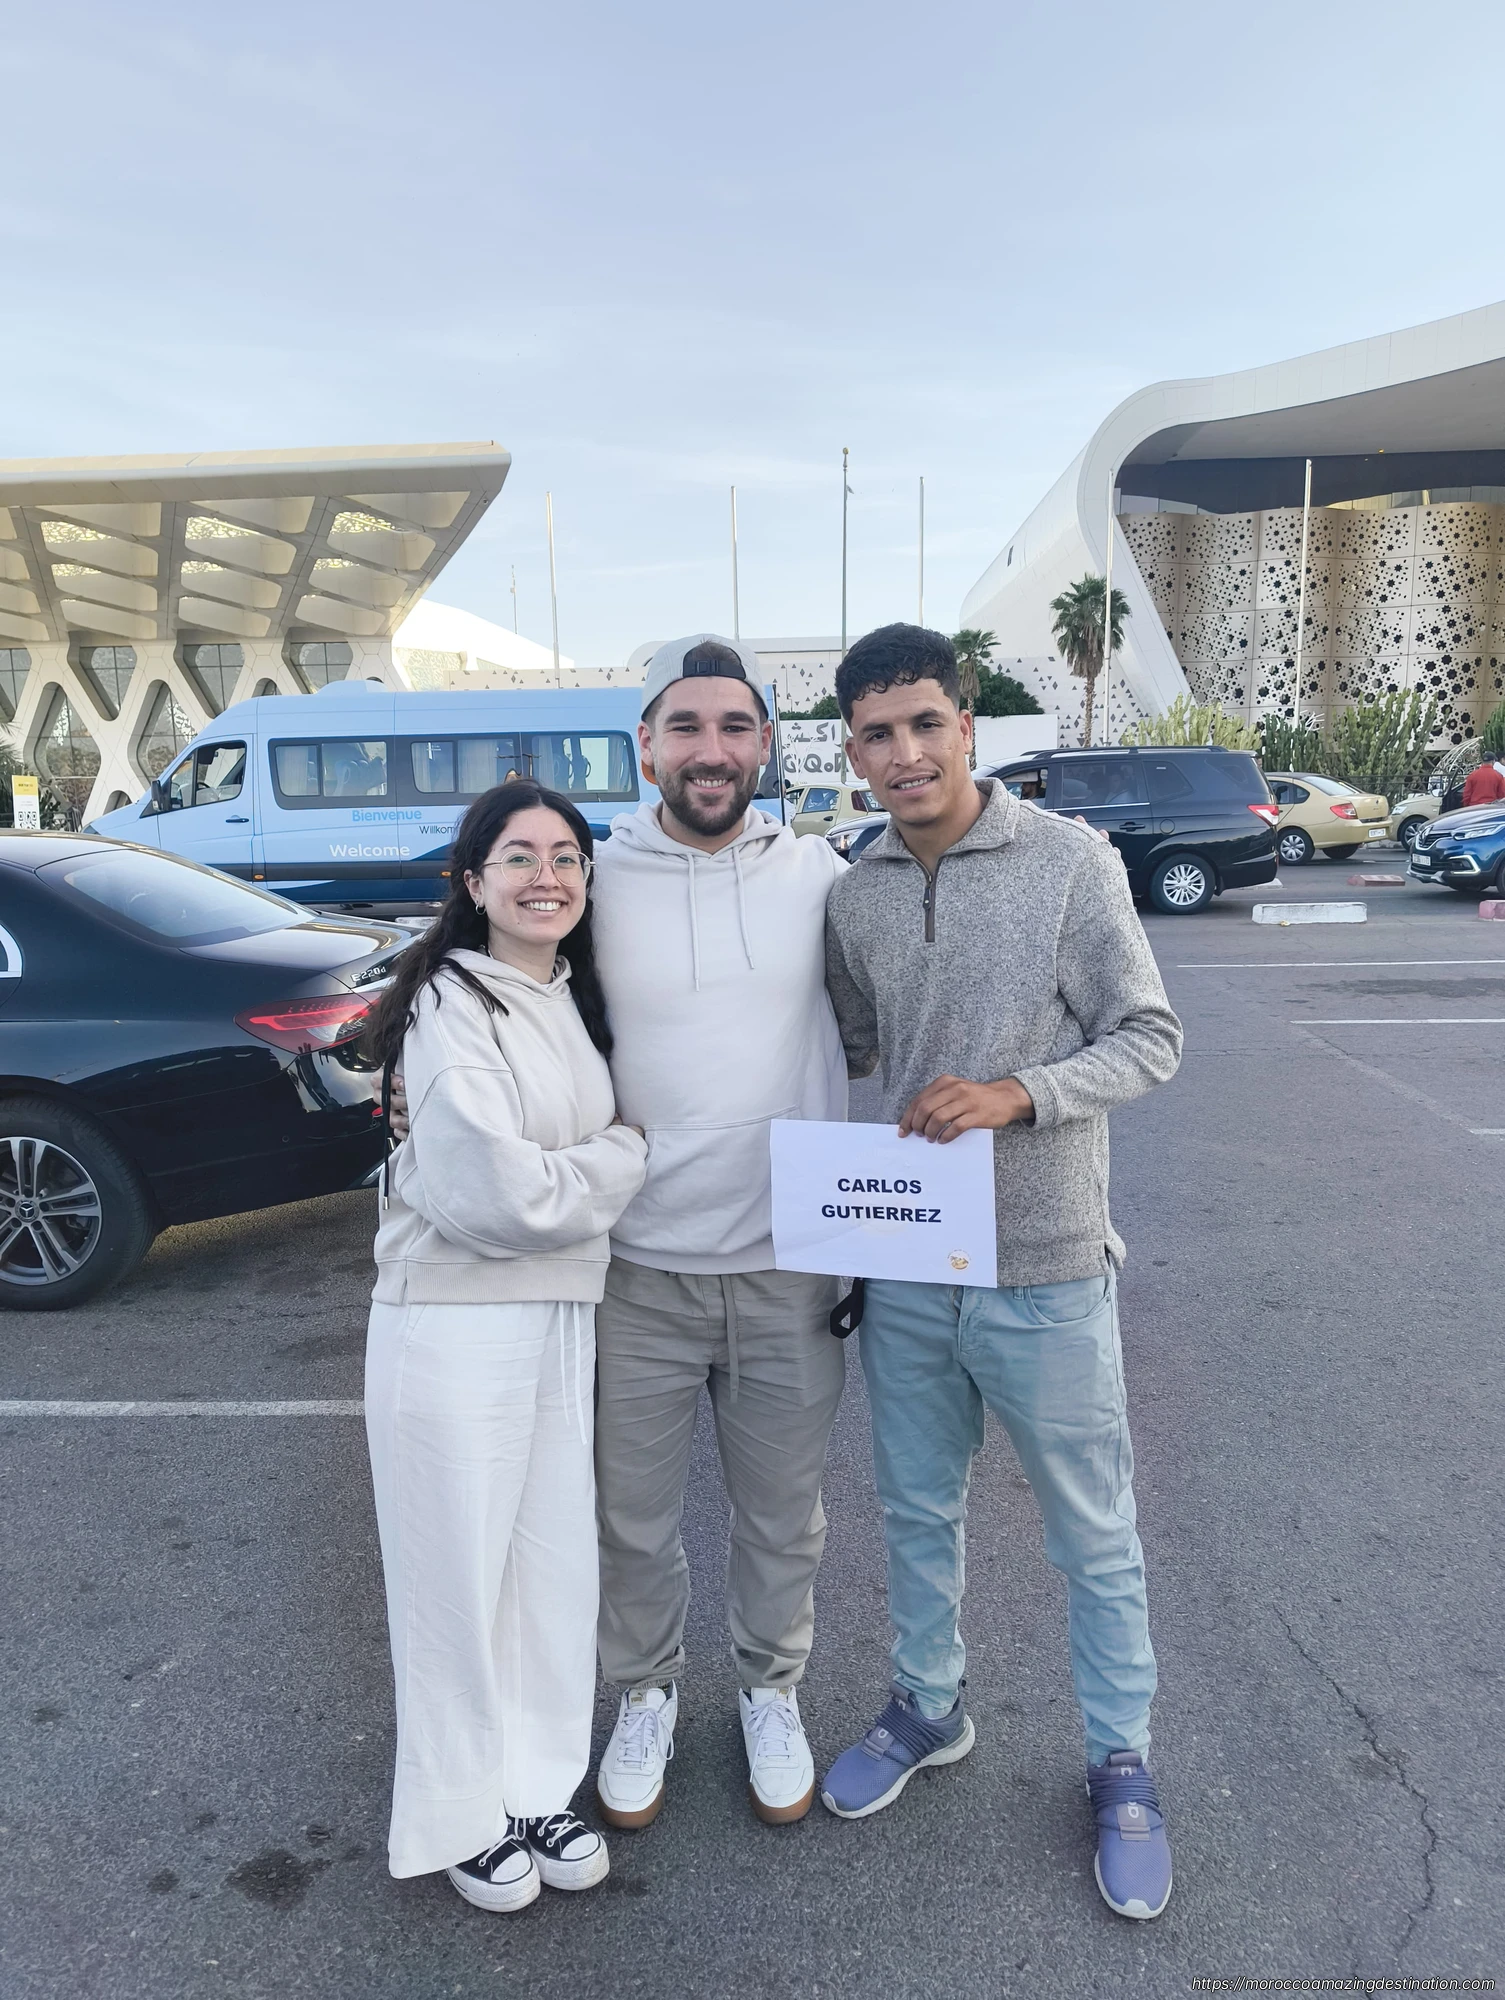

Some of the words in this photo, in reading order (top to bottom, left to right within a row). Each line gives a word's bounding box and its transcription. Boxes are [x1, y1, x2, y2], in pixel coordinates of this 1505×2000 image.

[351, 810, 422, 821] Bienvenue
[419, 825, 454, 834] Willkom
[329, 844, 410, 857] Welcome
[837, 1178, 922, 1194] CARLOS
[821, 1204, 942, 1223] GUTIERREZ
